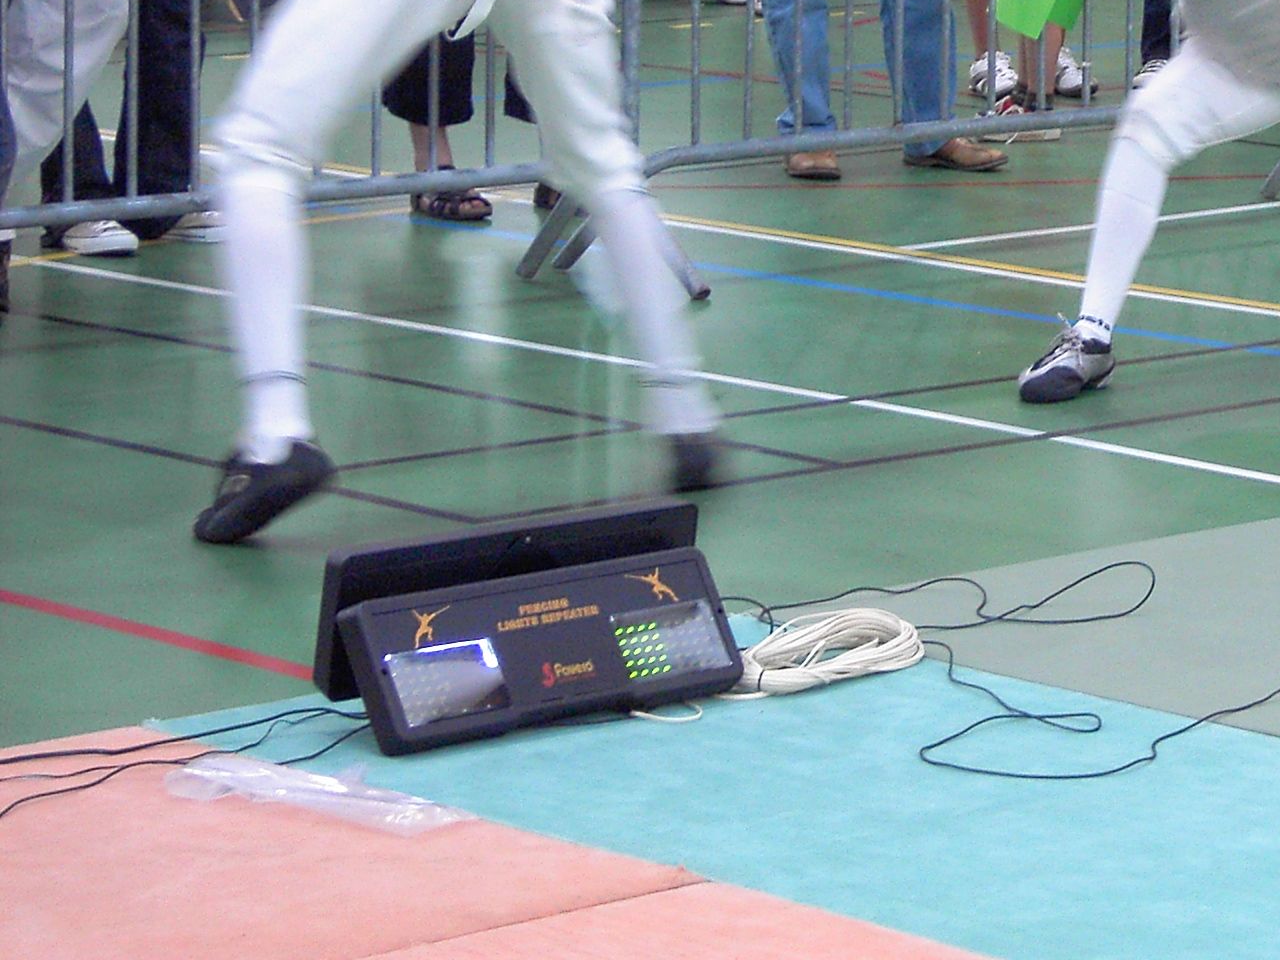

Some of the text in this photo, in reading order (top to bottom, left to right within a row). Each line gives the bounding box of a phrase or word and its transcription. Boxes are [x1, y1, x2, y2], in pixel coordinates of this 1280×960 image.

[519, 597, 569, 615] FENCING
[497, 604, 600, 632] LIGHTS REPEATER
